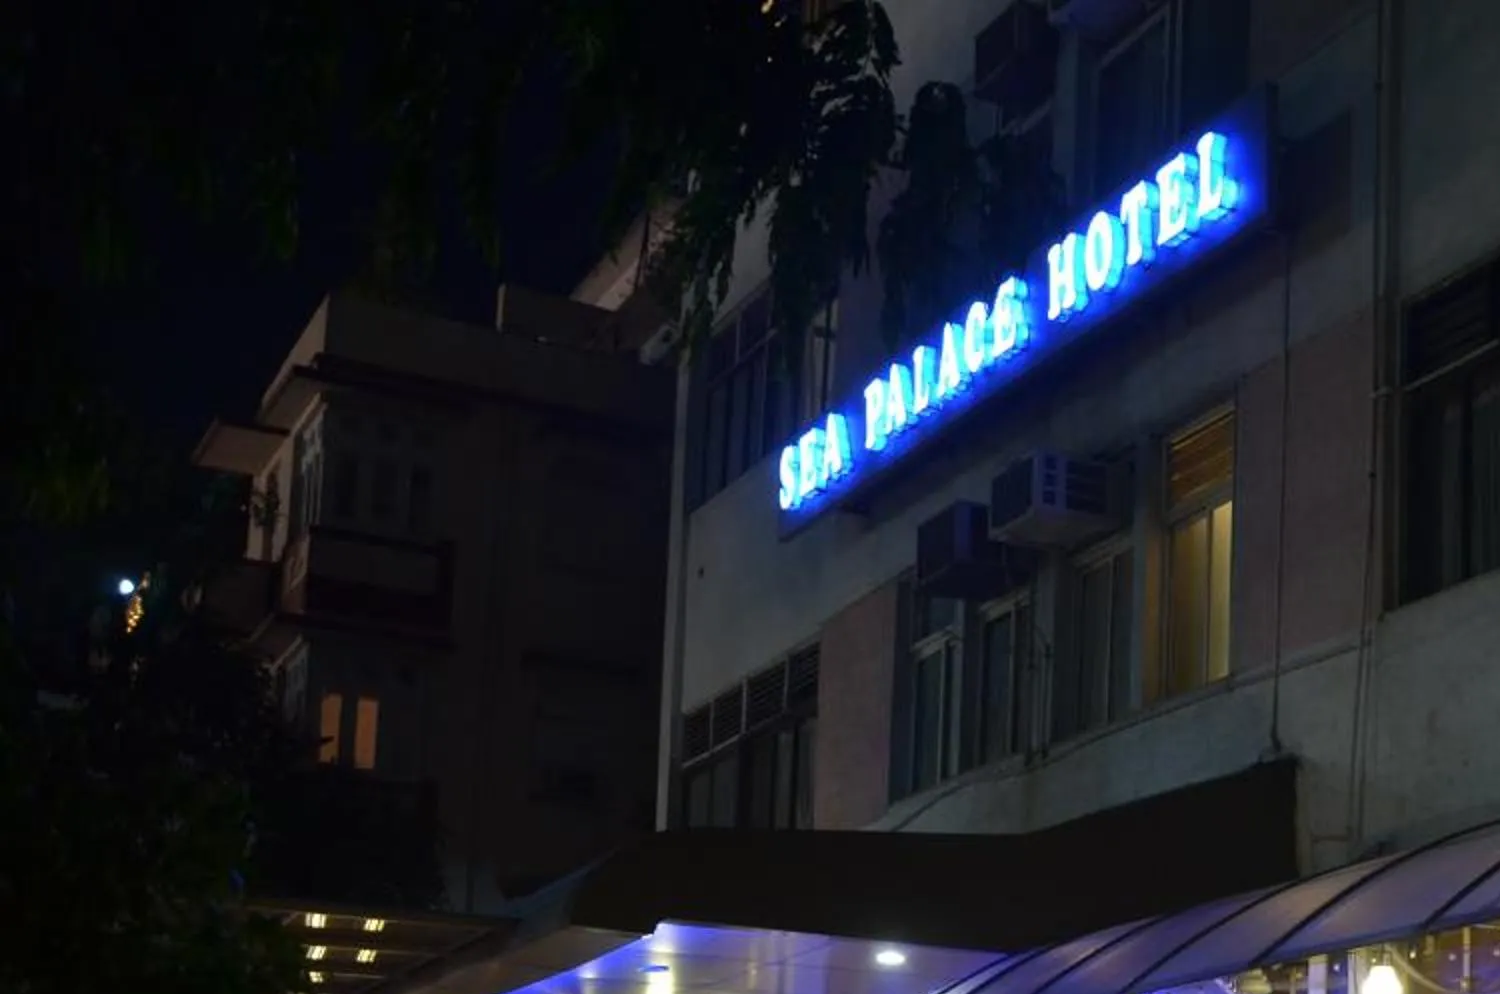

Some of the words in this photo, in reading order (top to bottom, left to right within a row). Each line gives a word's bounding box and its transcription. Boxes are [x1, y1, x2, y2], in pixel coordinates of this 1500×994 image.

[780, 413, 851, 509] SEA
[864, 276, 1031, 450] PALACE
[1048, 131, 1238, 320] HOTEL
